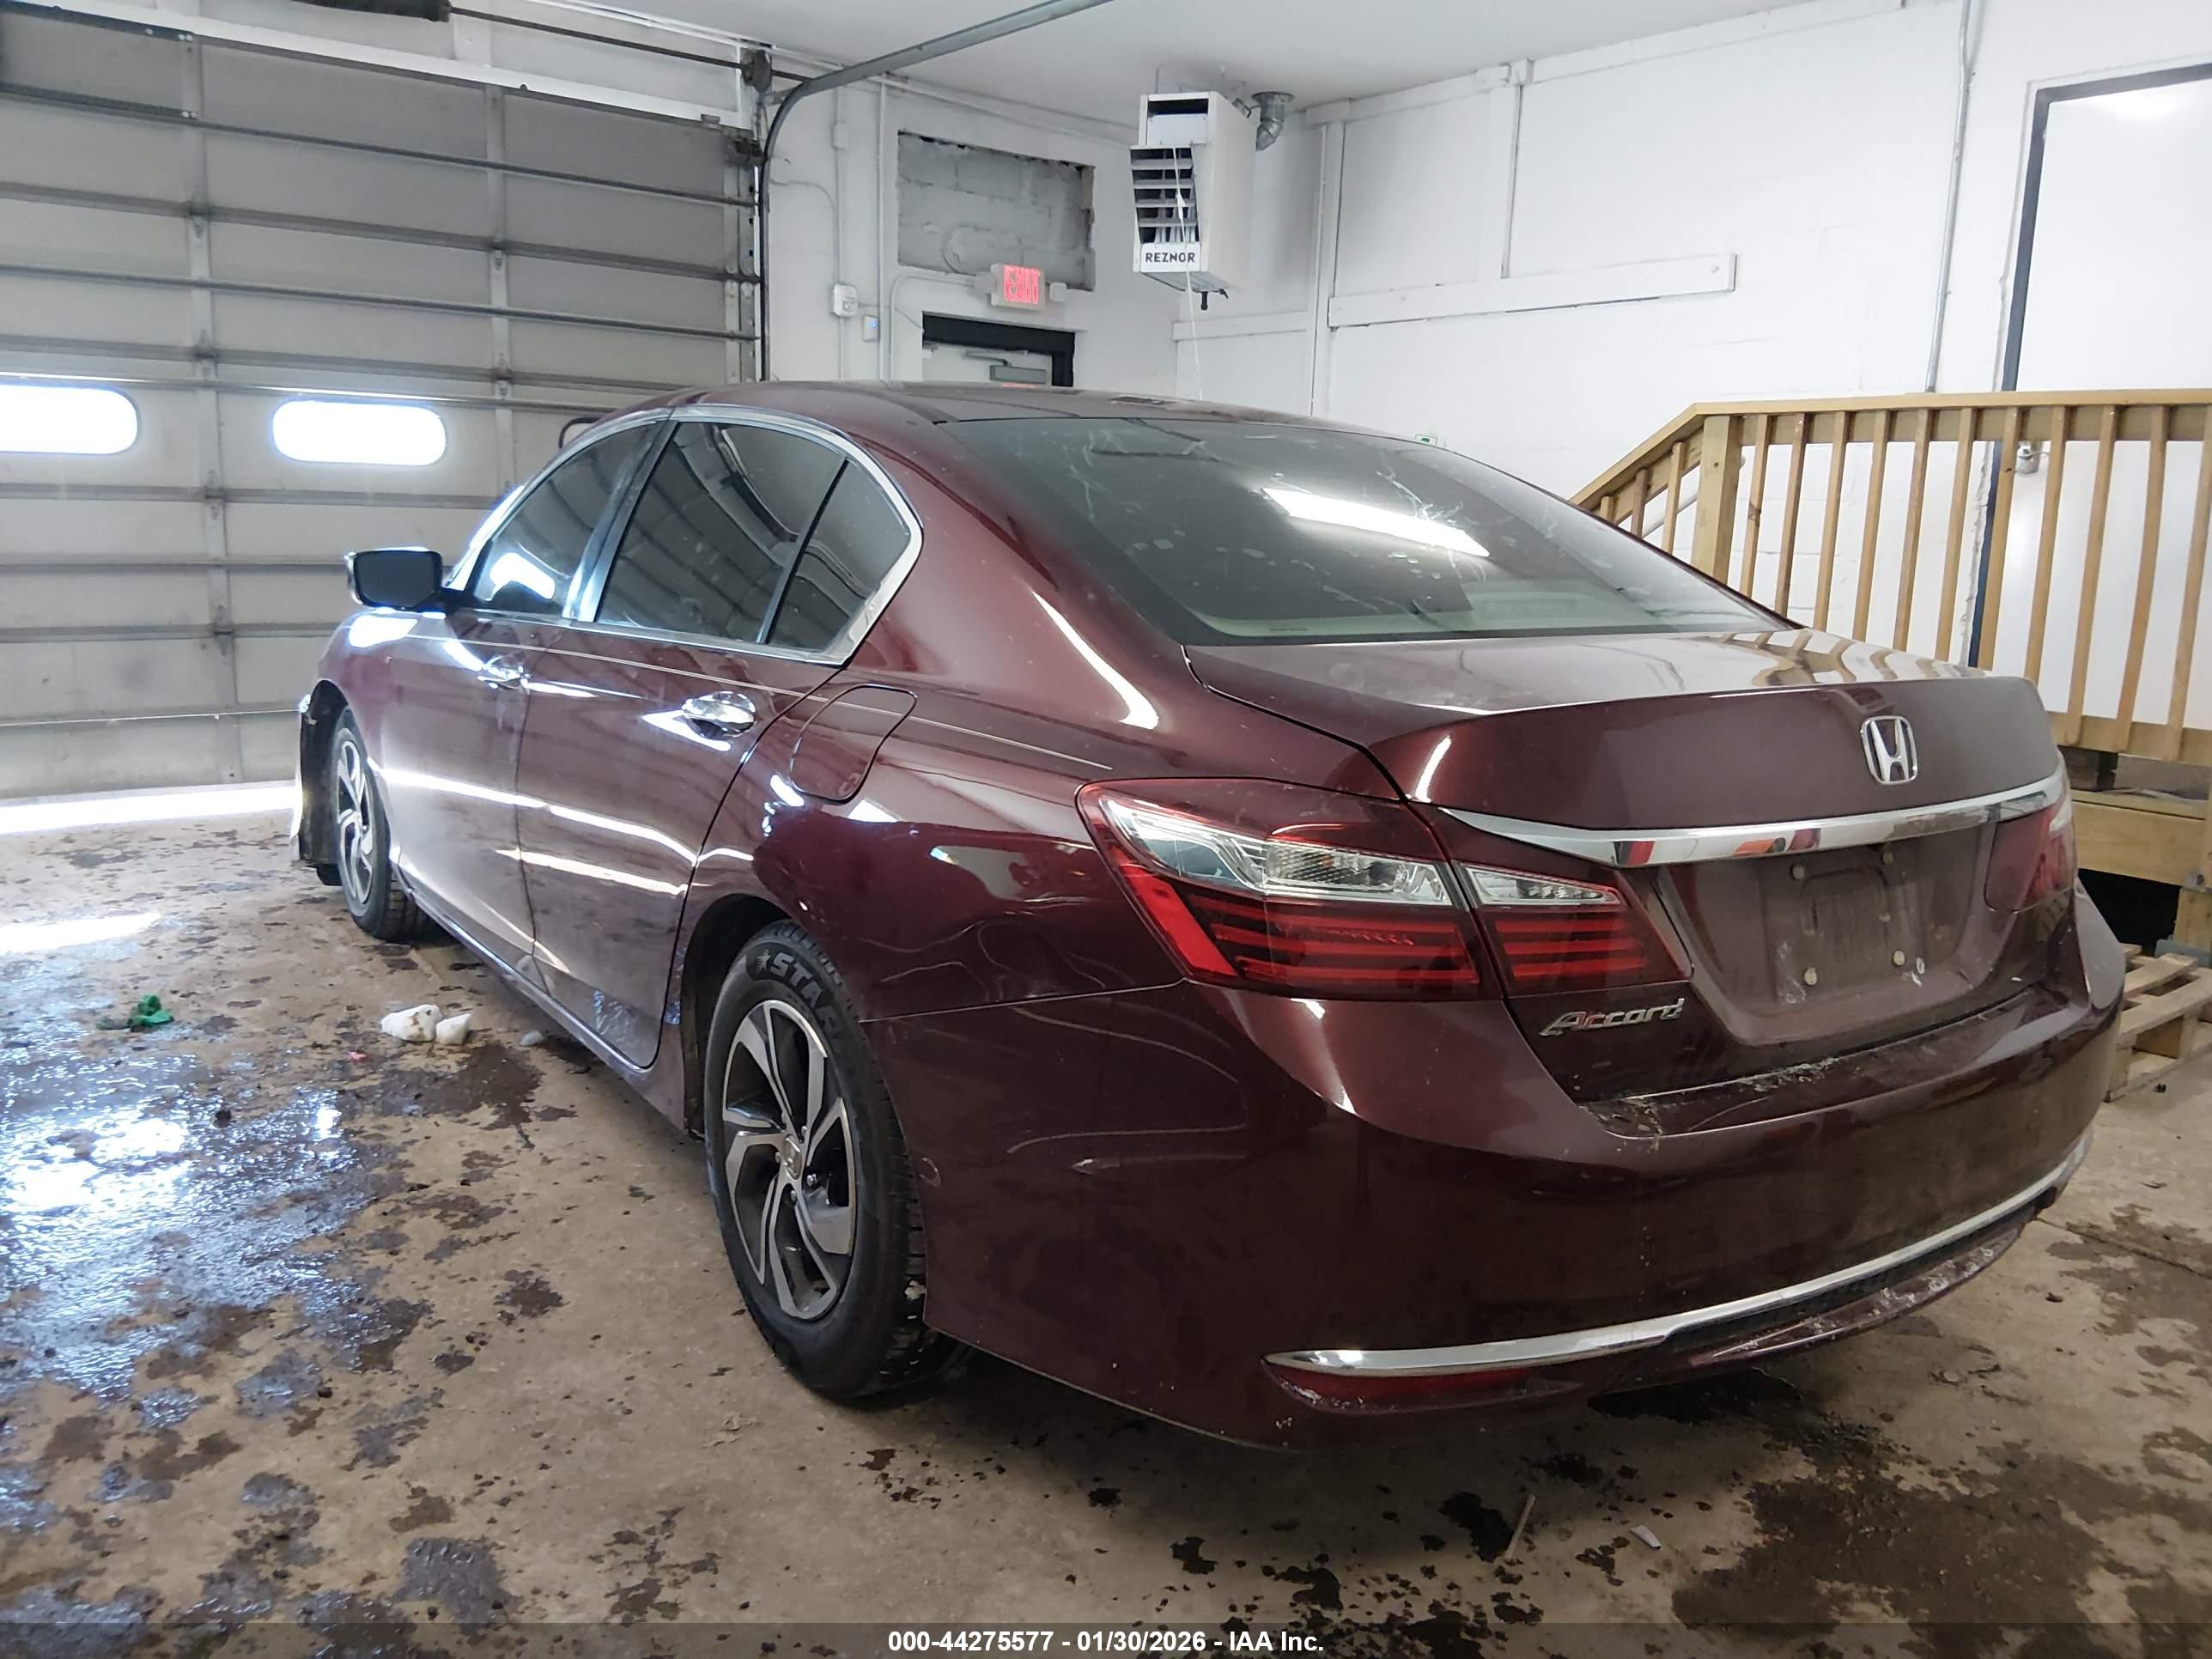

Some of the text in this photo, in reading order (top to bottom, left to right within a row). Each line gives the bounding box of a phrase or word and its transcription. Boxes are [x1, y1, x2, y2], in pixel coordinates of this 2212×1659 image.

[1145, 252, 1196, 263] REZNOR
[1003, 264, 1041, 304] EXIT
[1538, 997, 1686, 1036] Accord
